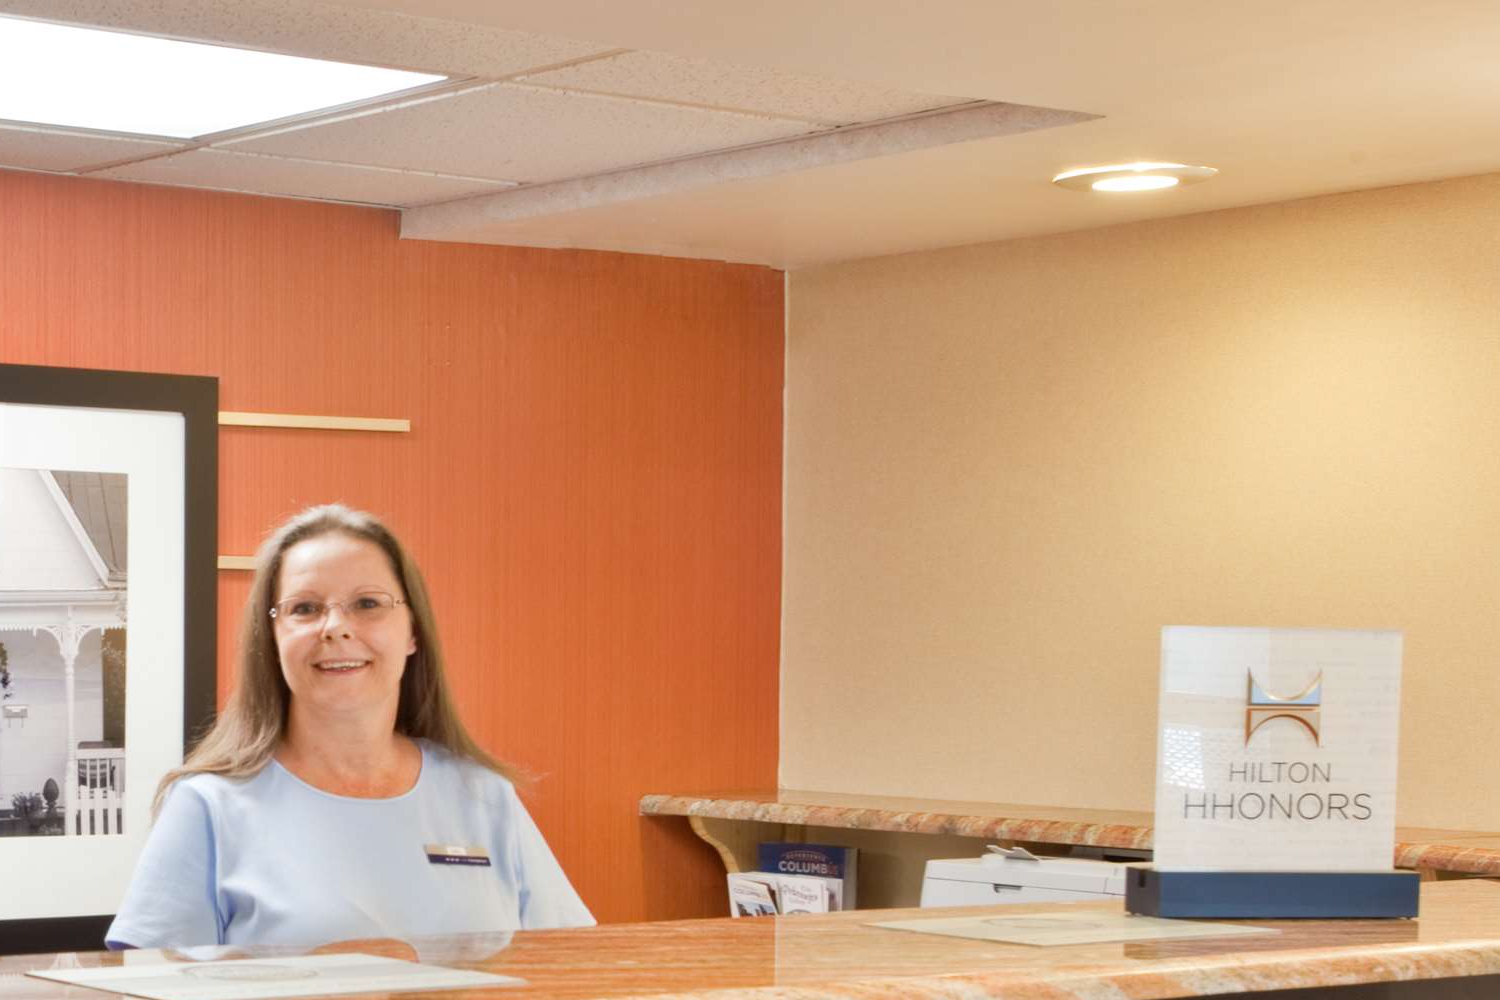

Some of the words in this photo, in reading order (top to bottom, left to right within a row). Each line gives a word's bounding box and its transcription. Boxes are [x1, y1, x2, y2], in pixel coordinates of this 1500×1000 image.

[1229, 762, 1331, 783] HILTON
[1184, 792, 1372, 820] HHONORS
[778, 861, 837, 875] COLUMB
